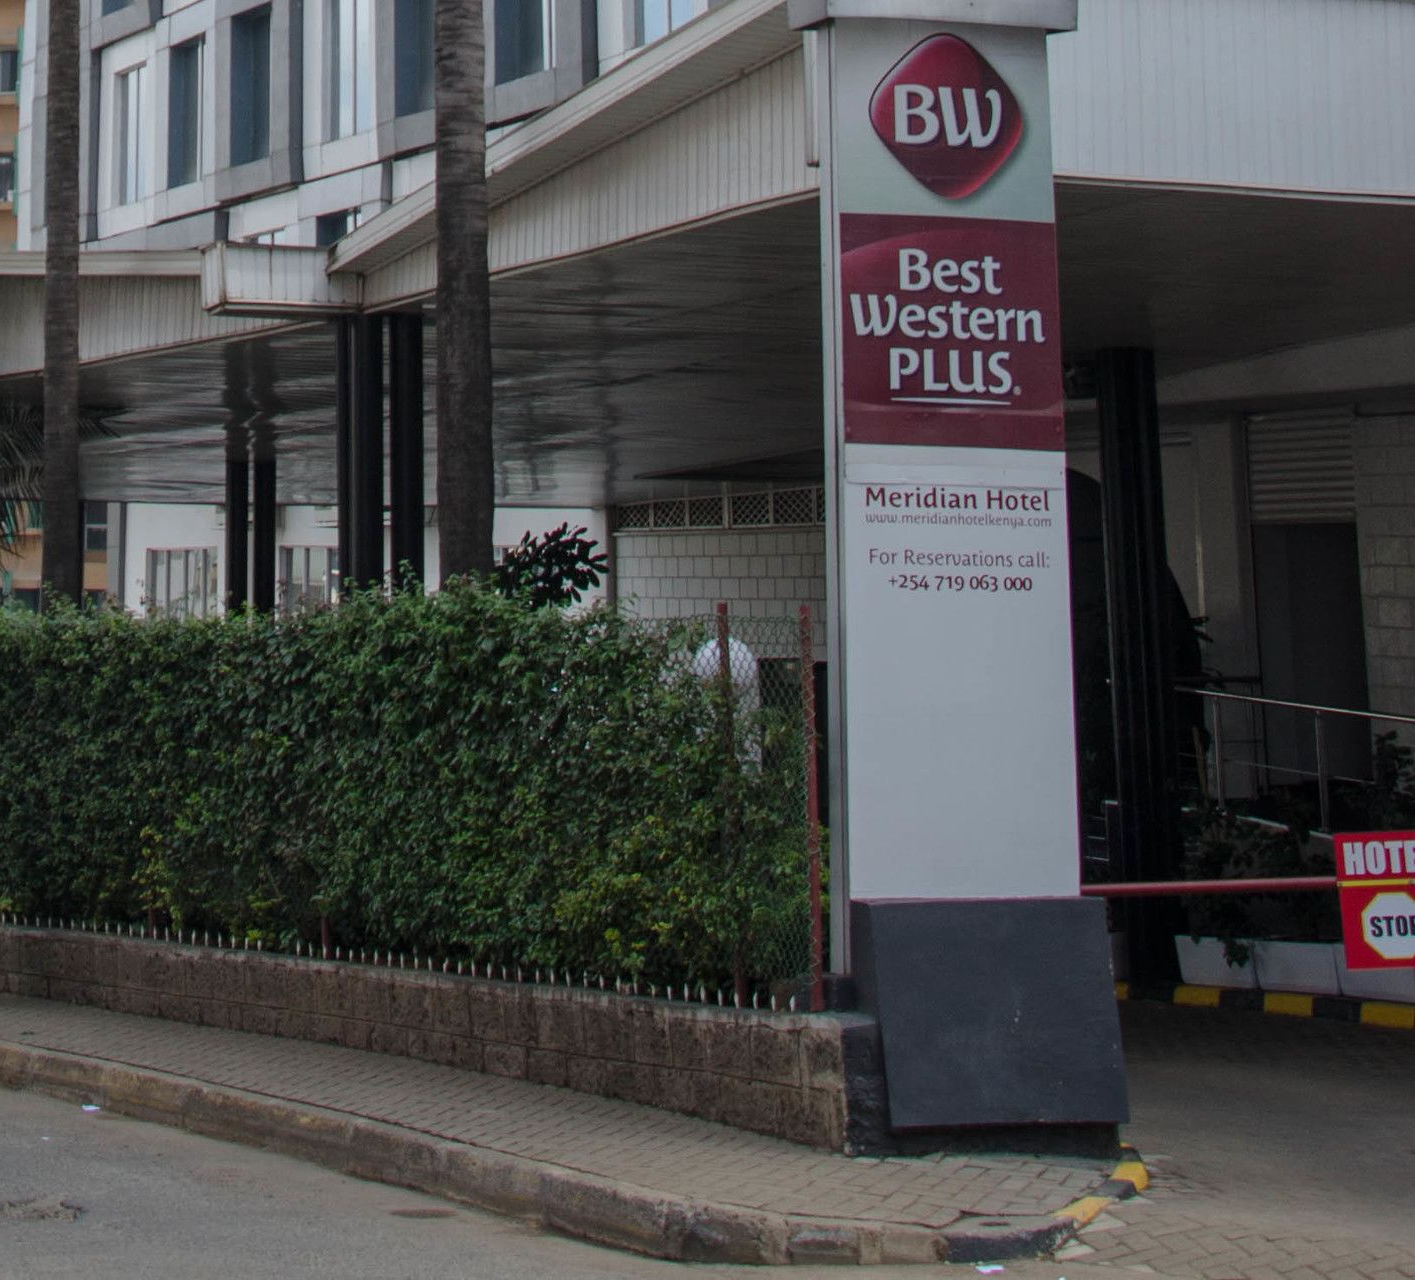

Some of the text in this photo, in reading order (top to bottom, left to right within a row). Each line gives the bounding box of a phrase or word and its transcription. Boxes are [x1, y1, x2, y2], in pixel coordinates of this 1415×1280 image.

[893, 84, 1002, 148] BW
[898, 248, 1002, 295] Best
[849, 293, 1045, 343] Western
[865, 486, 1050, 512] Meridian Hotel
[865, 512, 1052, 529] www.meridianhotelkenya.com
[868, 548, 1051, 569] For Reservations call:
[888, 574, 1033, 592] +254 719 063 000
